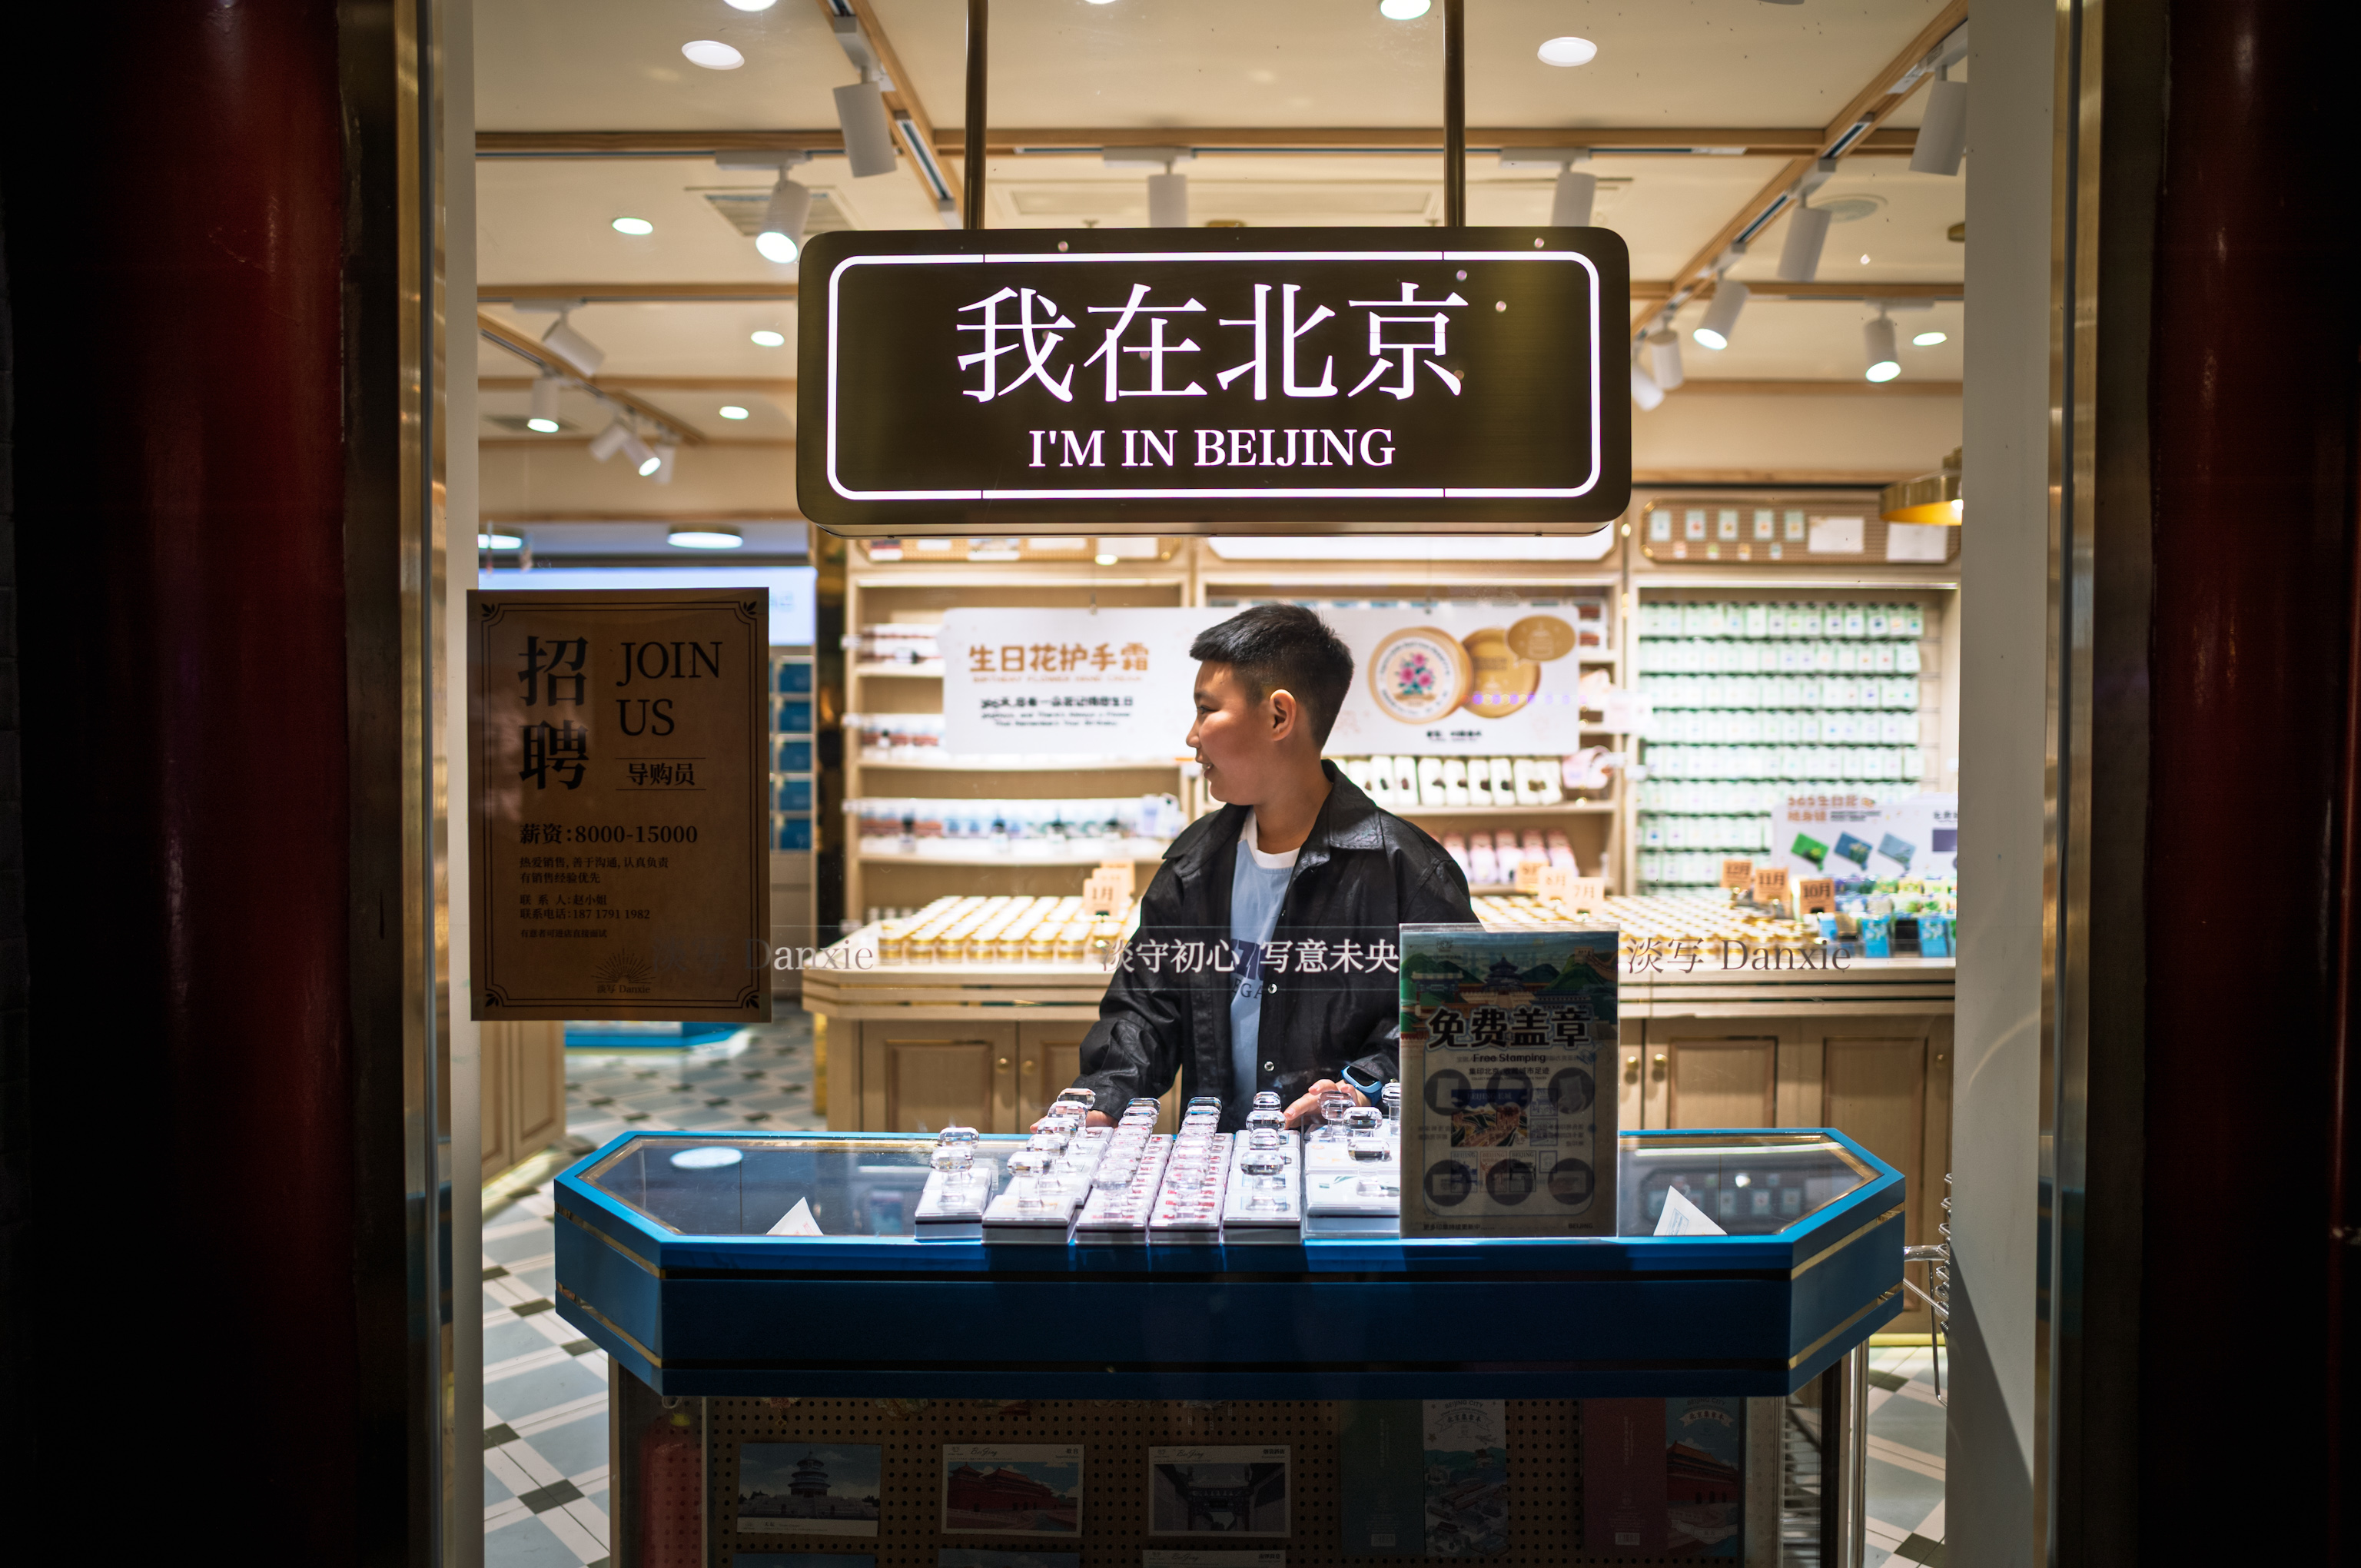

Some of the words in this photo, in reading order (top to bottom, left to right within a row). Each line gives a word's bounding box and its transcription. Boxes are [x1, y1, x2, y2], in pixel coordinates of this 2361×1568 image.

[955, 282, 1469, 402] 我在北京
[1029, 428, 1105, 468] I'M
[1121, 428, 1175, 468] IN
[1195, 427, 1396, 468] BEIJING
[616, 642, 723, 687] JOIN
[969, 643, 1148, 673] 生日花护手霜
[519, 636, 589, 790] 招聘
[616, 698, 676, 737] US
[627, 762, 695, 786] 导购员
[520, 872, 601, 885] 有销售经验优先
[1759, 872, 1785, 885] 11月
[1803, 883, 1831, 898] 10月
[596, 909, 621, 920] 1791
[625, 909, 650, 920] 1982
[745, 938, 874, 971] Danxie
[1260, 938, 1400, 974] 写意未央
[1625, 937, 1705, 974] 淡写
[1721, 939, 1851, 972] Danxie
[619, 984, 651, 994] Danxie
[1427, 1007, 1591, 1048] 免费盖章
[1473, 1054, 1496, 1062] Free
[1499, 1054, 1546, 1064] Stamping
[1445, 1400, 1467, 1409] BEIJING
[1469, 1400, 1483, 1408] CITY
